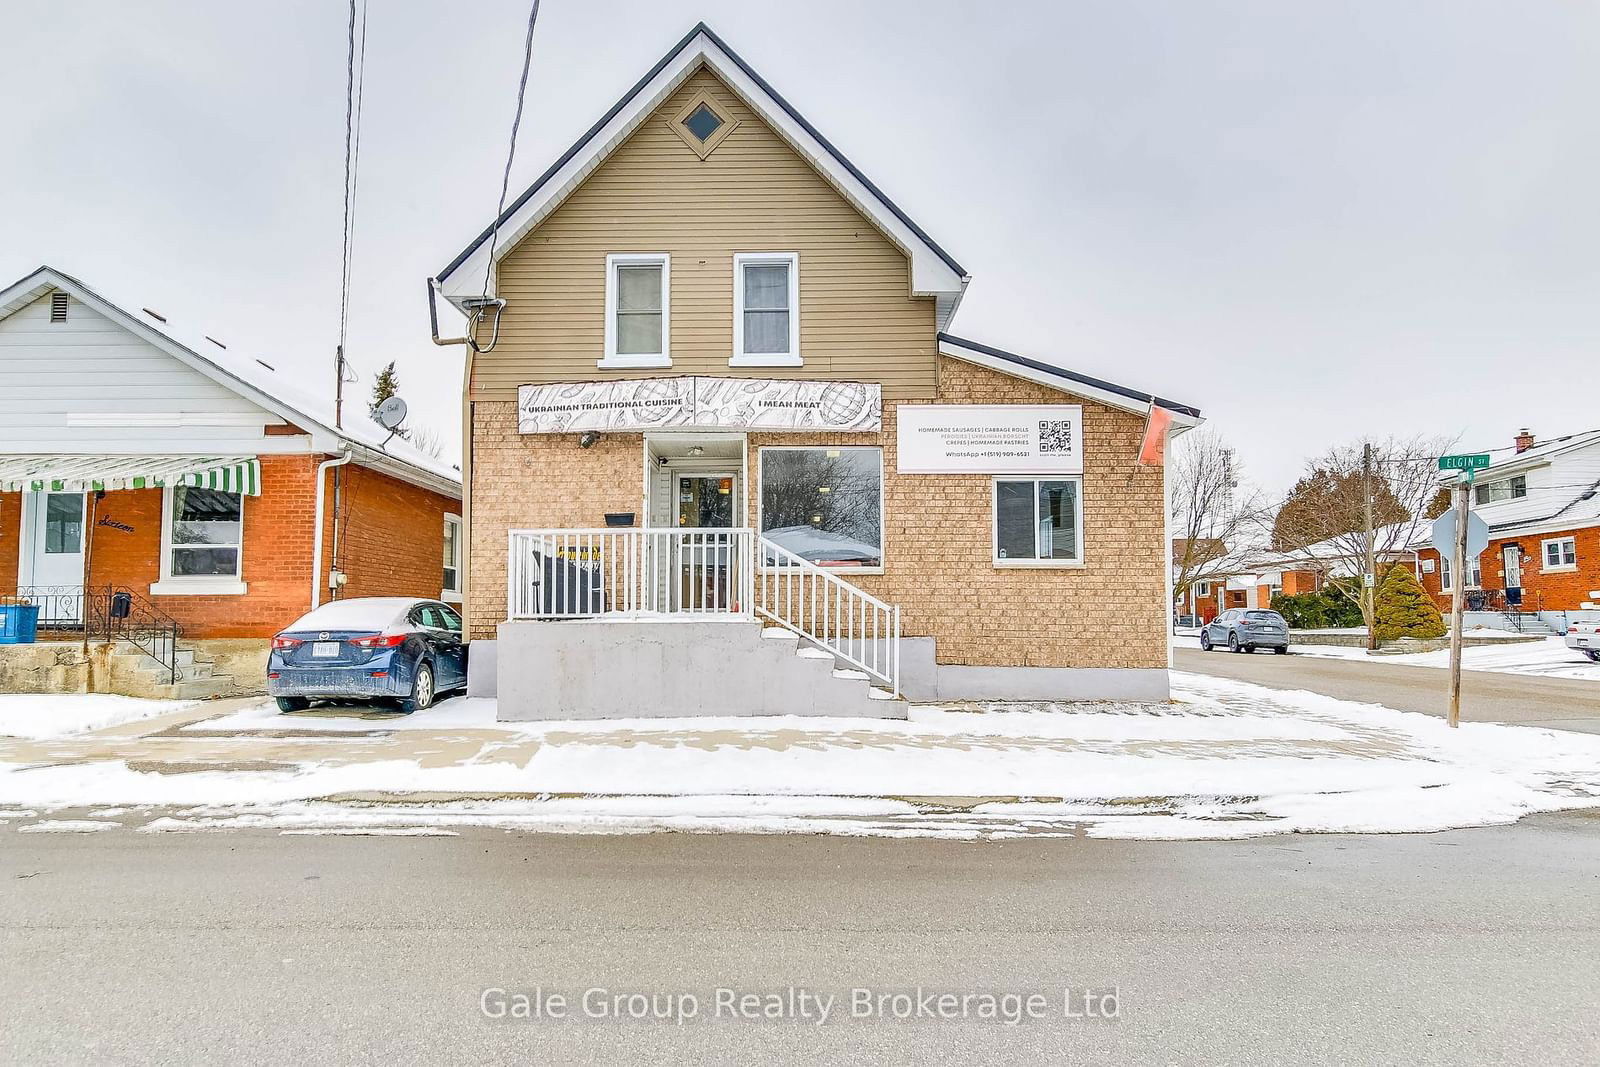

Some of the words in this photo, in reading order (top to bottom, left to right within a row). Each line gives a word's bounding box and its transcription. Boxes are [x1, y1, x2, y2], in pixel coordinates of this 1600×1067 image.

[528, 404, 579, 413] UKRAINIAN
[580, 401, 644, 412] TRADITIONAL
[645, 398, 683, 408] CUISINE
[763, 400, 793, 408] MEAN
[794, 401, 822, 409] MEAT
[1446, 457, 1474, 468] ELGIN
